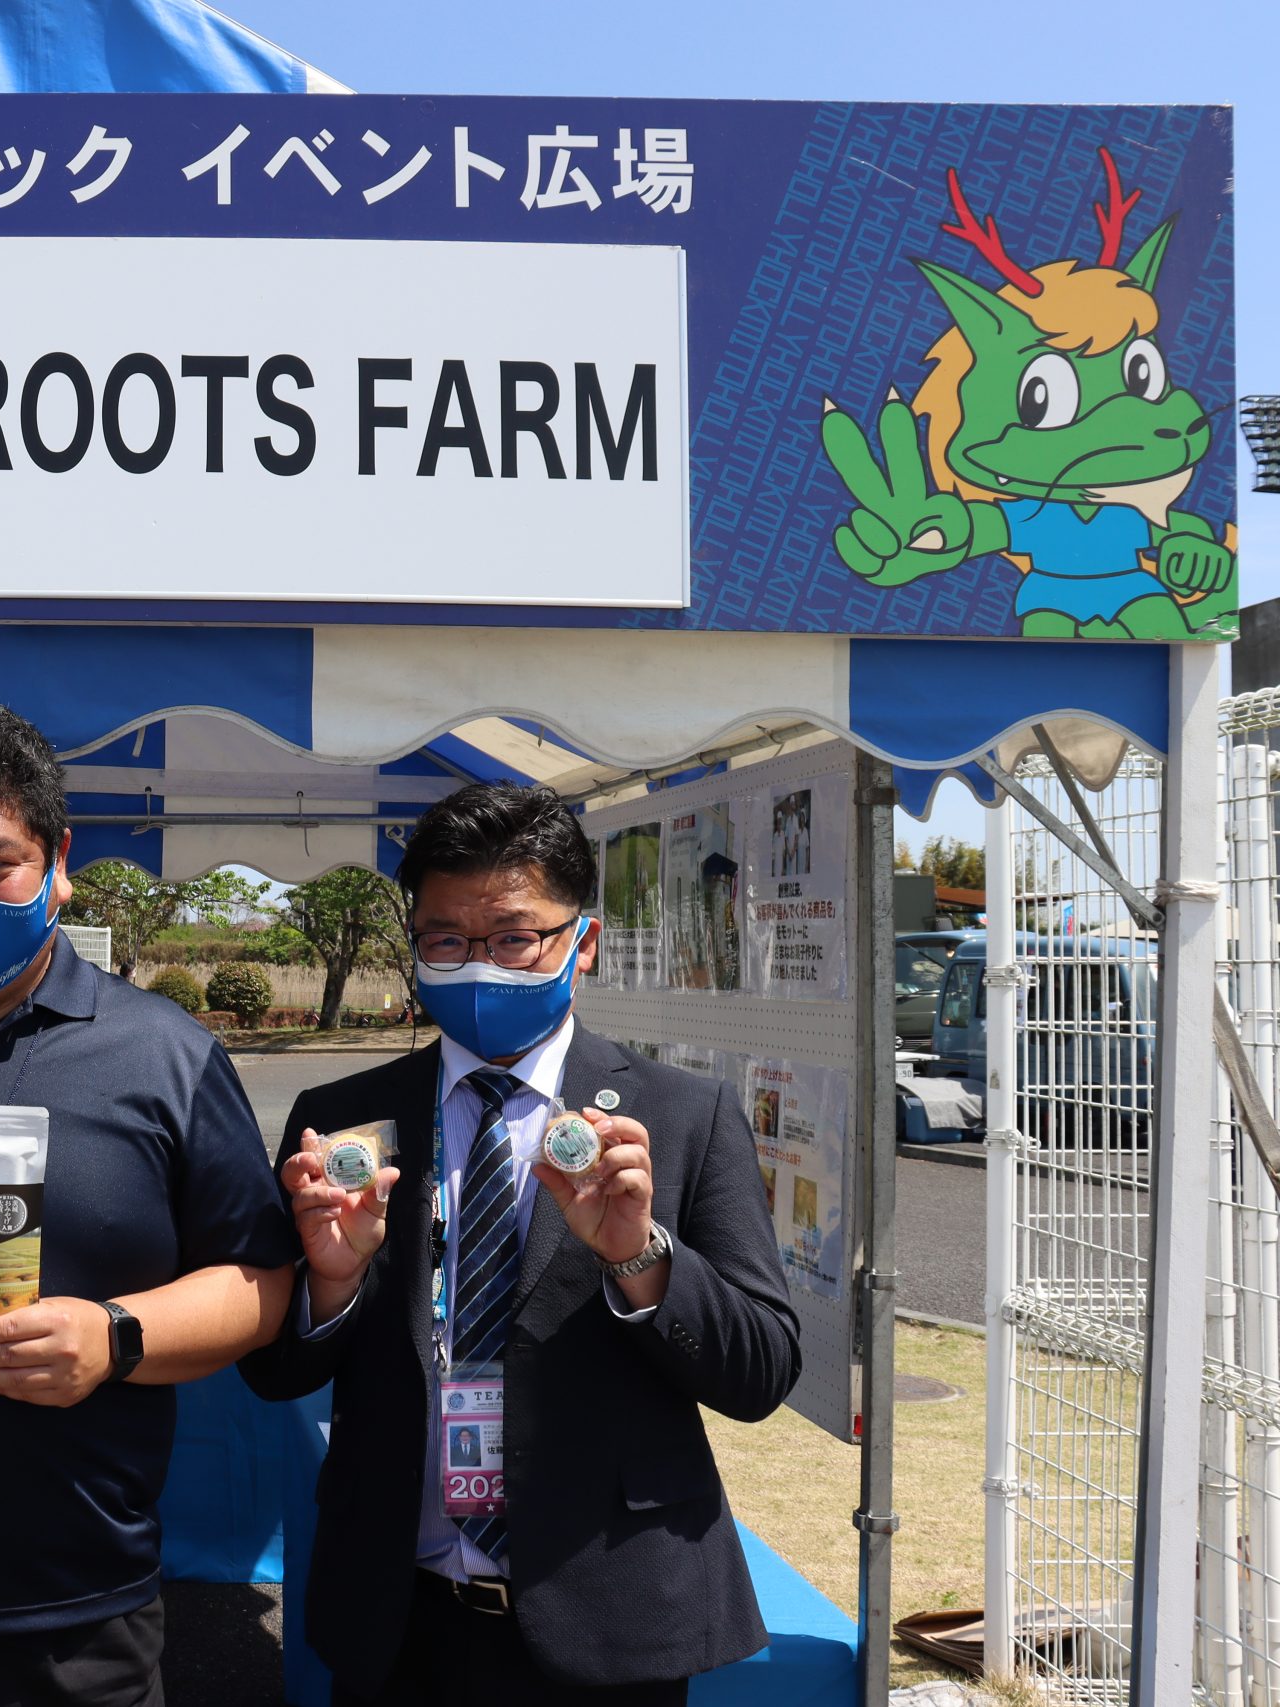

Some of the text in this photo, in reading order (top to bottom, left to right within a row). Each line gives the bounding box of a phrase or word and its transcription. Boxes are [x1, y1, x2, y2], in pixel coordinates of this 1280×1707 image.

[181, 124, 694, 213] イベント広場
[357, 357, 659, 482] FARM
